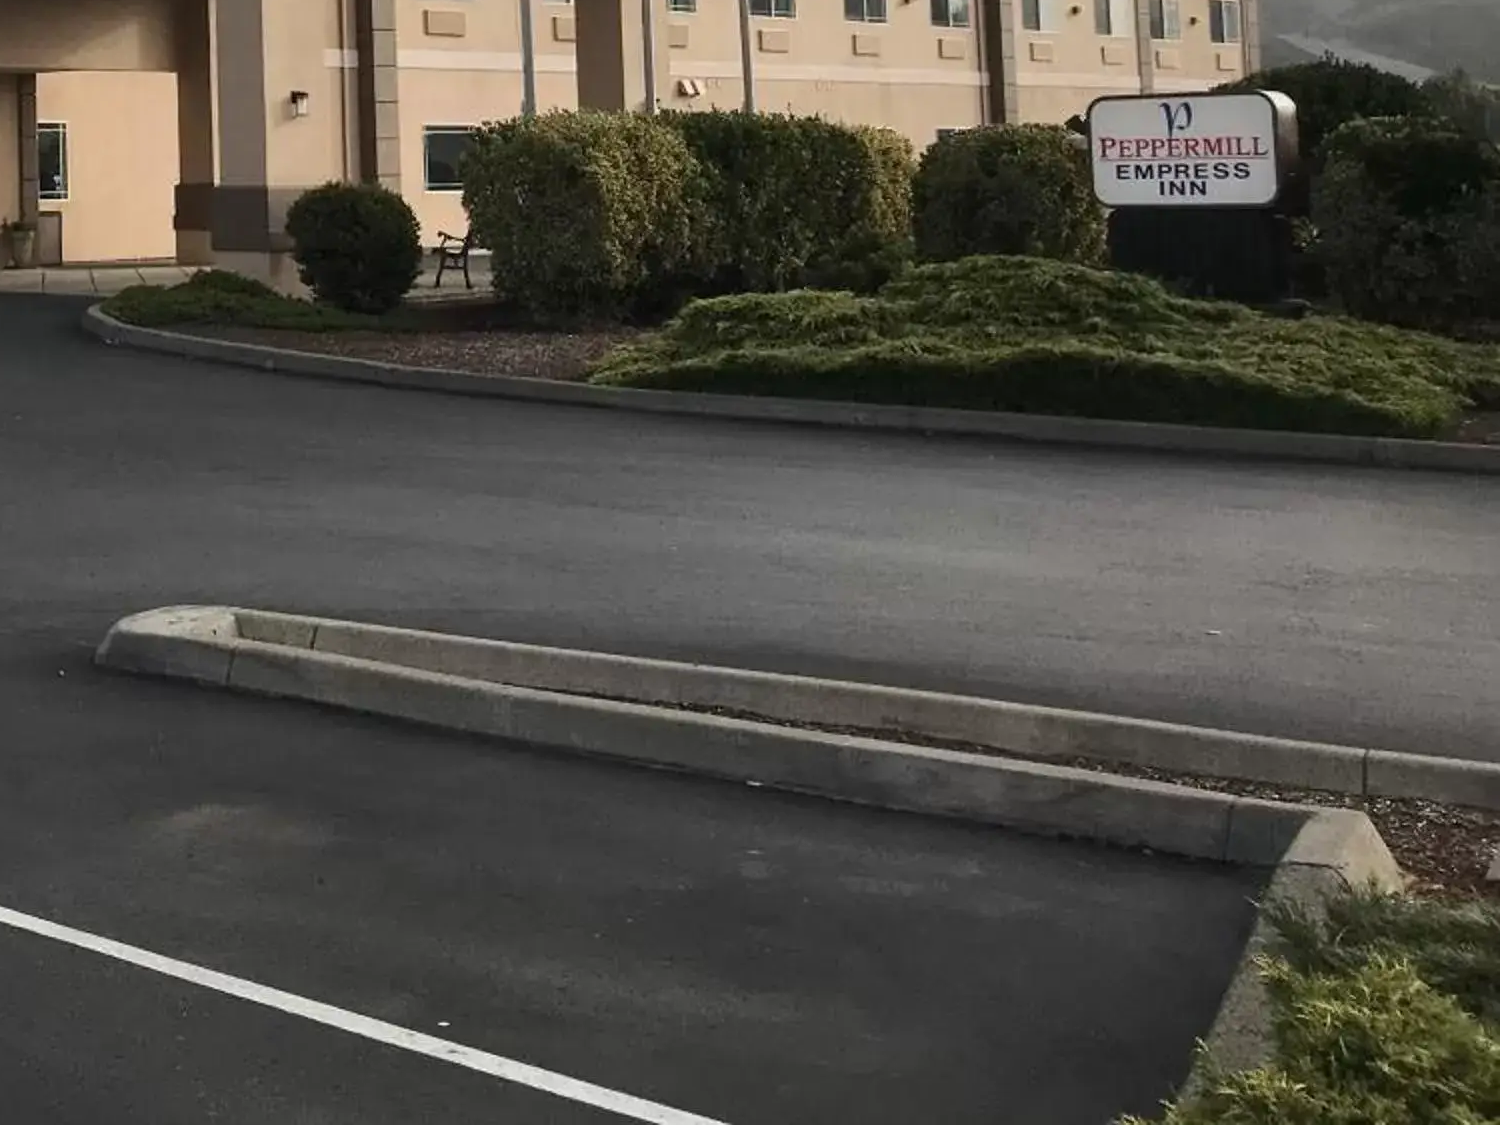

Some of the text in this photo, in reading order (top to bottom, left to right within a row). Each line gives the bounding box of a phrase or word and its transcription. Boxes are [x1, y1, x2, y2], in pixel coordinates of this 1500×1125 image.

[1099, 136, 1269, 159] PEPPERMILL
[1115, 162, 1251, 181] EMPRESS
[1158, 180, 1208, 197] INN
